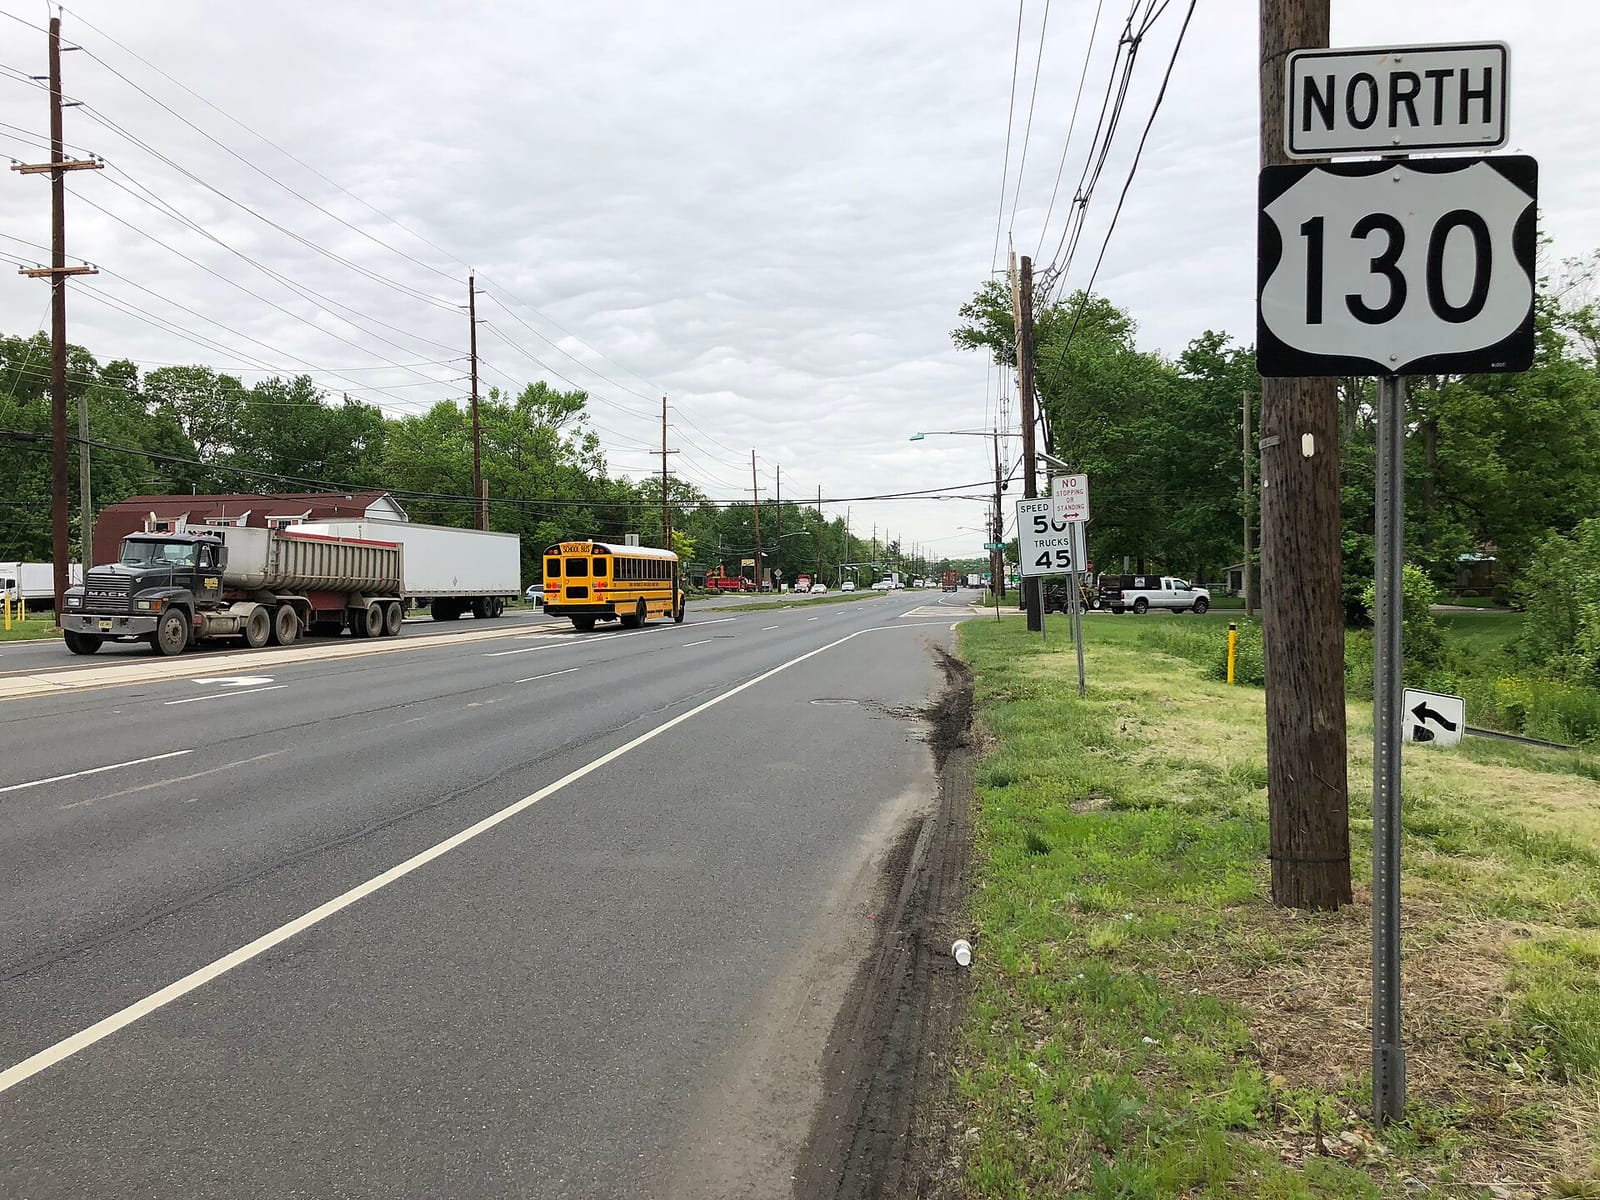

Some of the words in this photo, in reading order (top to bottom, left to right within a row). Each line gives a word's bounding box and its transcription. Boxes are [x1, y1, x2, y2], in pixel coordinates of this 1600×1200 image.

[1303, 67, 1492, 132] NORTH
[1300, 209, 1492, 325] 130
[1062, 478, 1077, 488] NO
[1056, 489, 1084, 497] STOPPING
[1020, 504, 1049, 513] SPEED
[1034, 538, 1069, 548] TRUCKS
[563, 545, 580, 553] SCHOOL
[581, 545, 590, 553] BUS
[1035, 550, 1071, 569] 45
